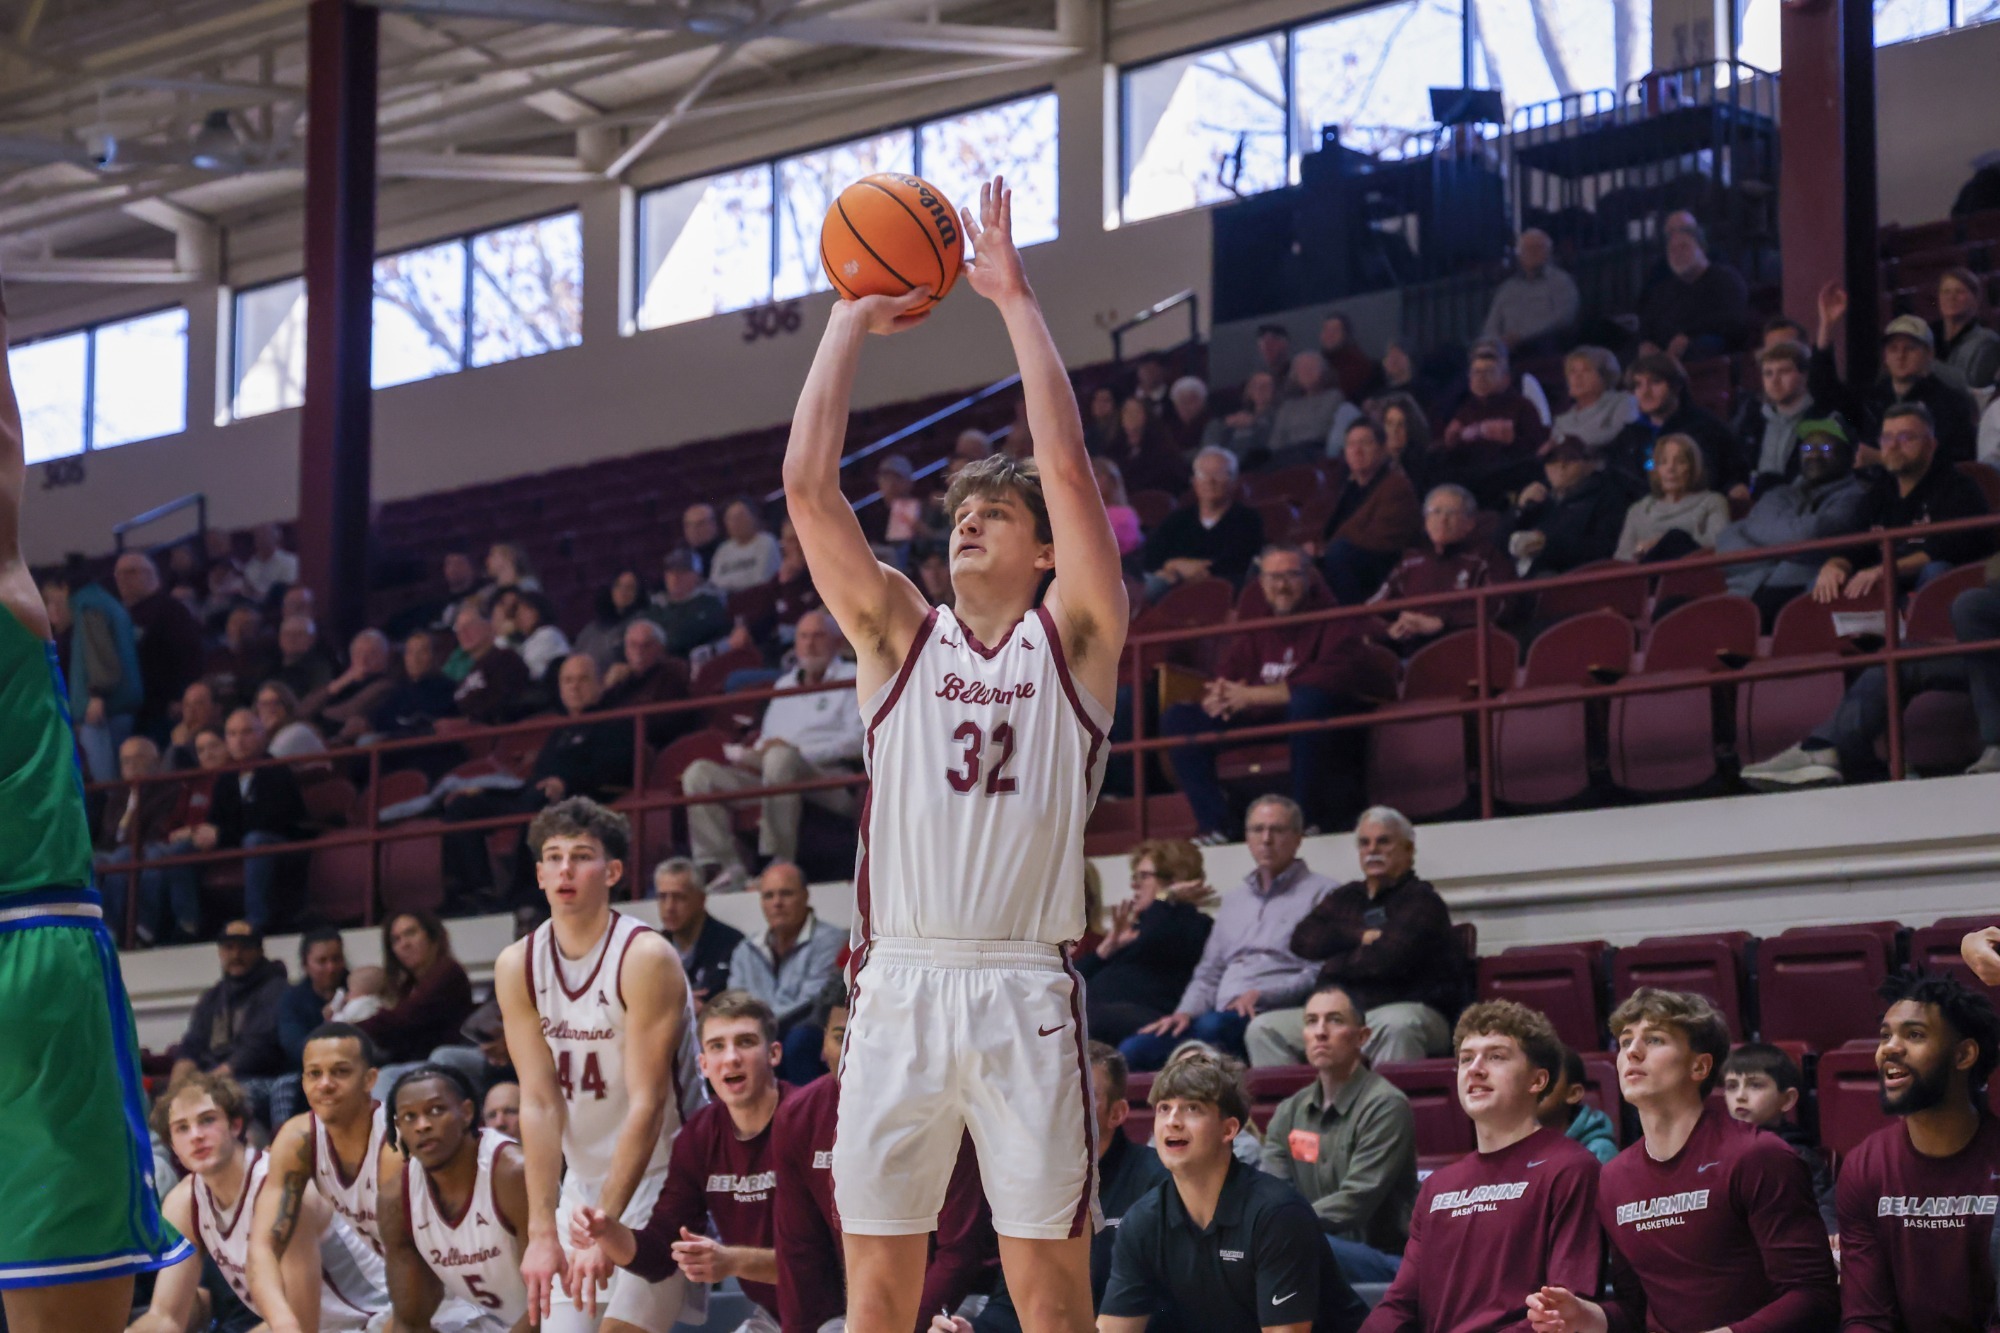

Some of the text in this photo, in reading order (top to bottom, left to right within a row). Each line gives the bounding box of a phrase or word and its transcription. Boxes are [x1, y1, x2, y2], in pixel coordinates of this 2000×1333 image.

[743, 302, 802, 342] 306
[945, 720, 1020, 798] 32
[558, 1051, 608, 1101] 44
[1429, 1181, 1529, 1213] BELLARMINE
[1616, 1189, 1710, 1226] BELLARMINE
[1635, 1216, 1685, 1232] BASKETBALL
[1903, 1218, 1966, 1229] BASKETBALL
[462, 1274, 504, 1309] 5
